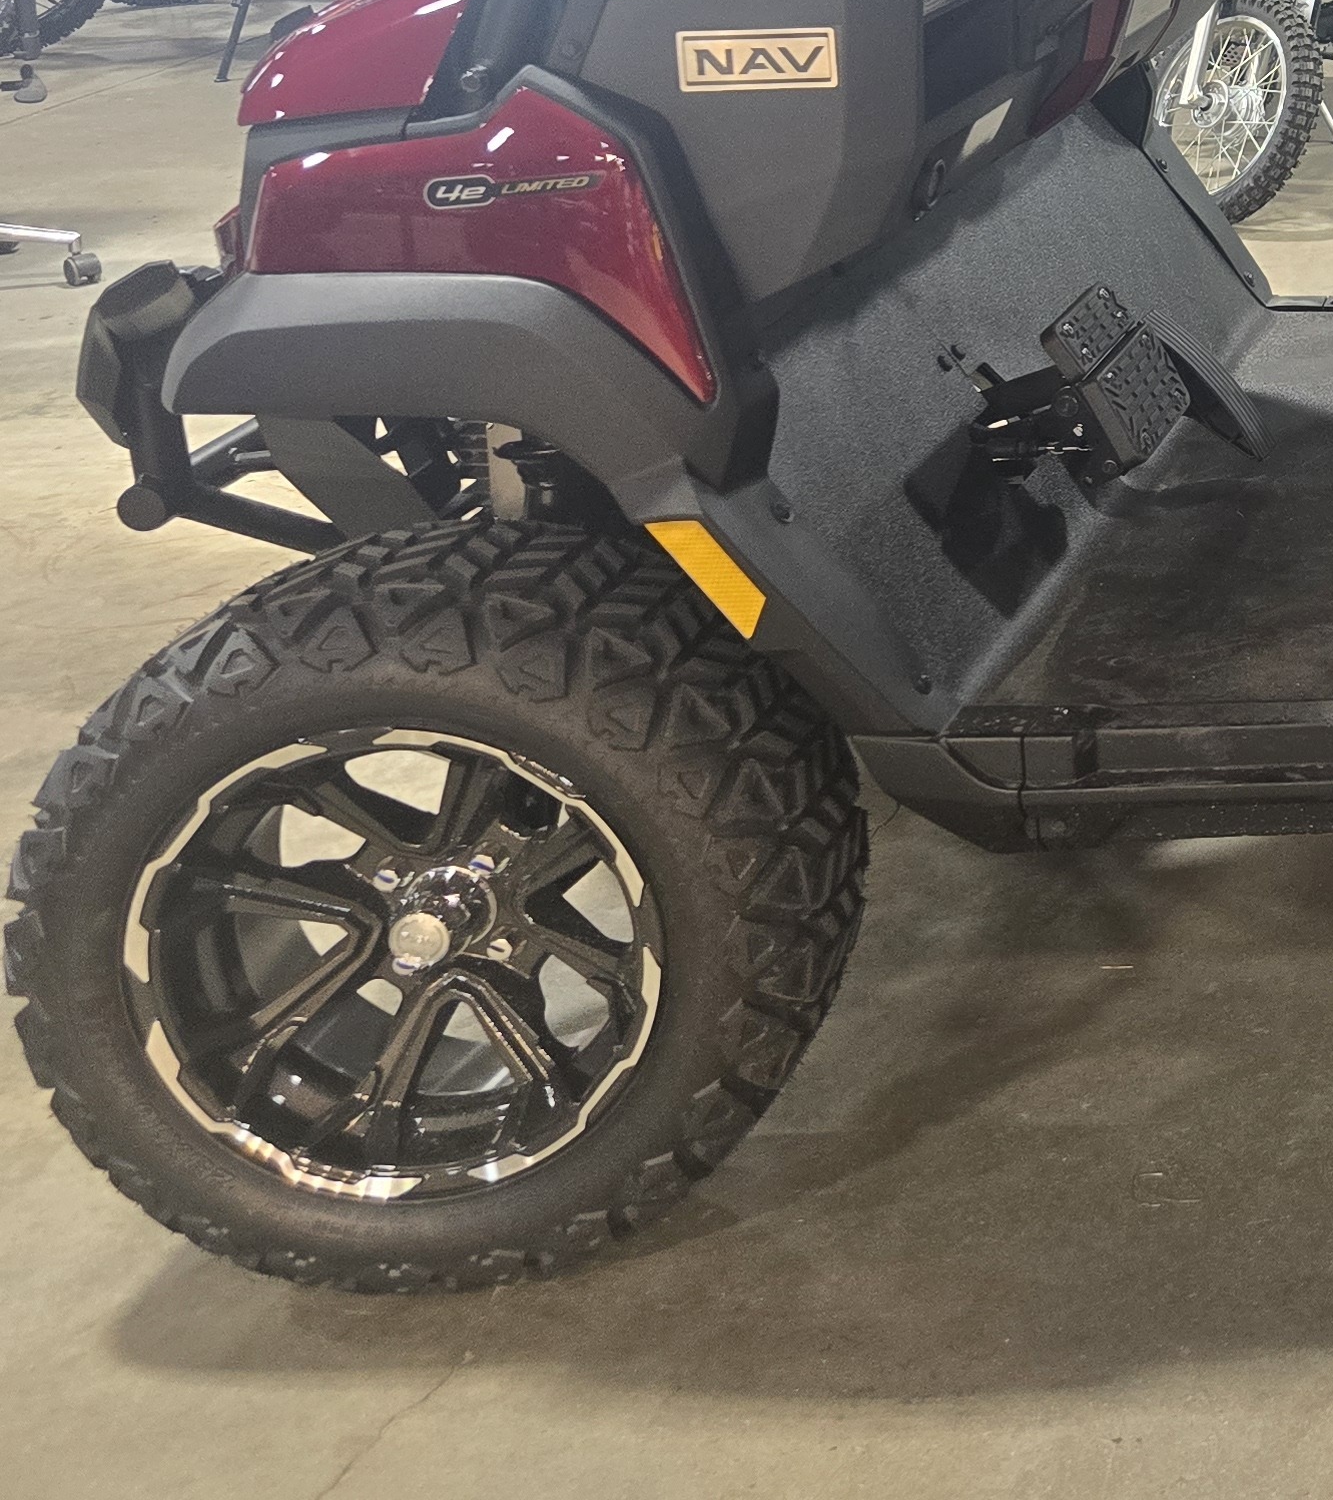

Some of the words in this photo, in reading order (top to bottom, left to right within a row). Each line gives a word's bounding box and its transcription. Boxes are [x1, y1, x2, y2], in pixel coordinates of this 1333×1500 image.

[694, 45, 825, 76] NAV
[435, 181, 487, 202] 4e
[500, 175, 592, 196] LIMITED
